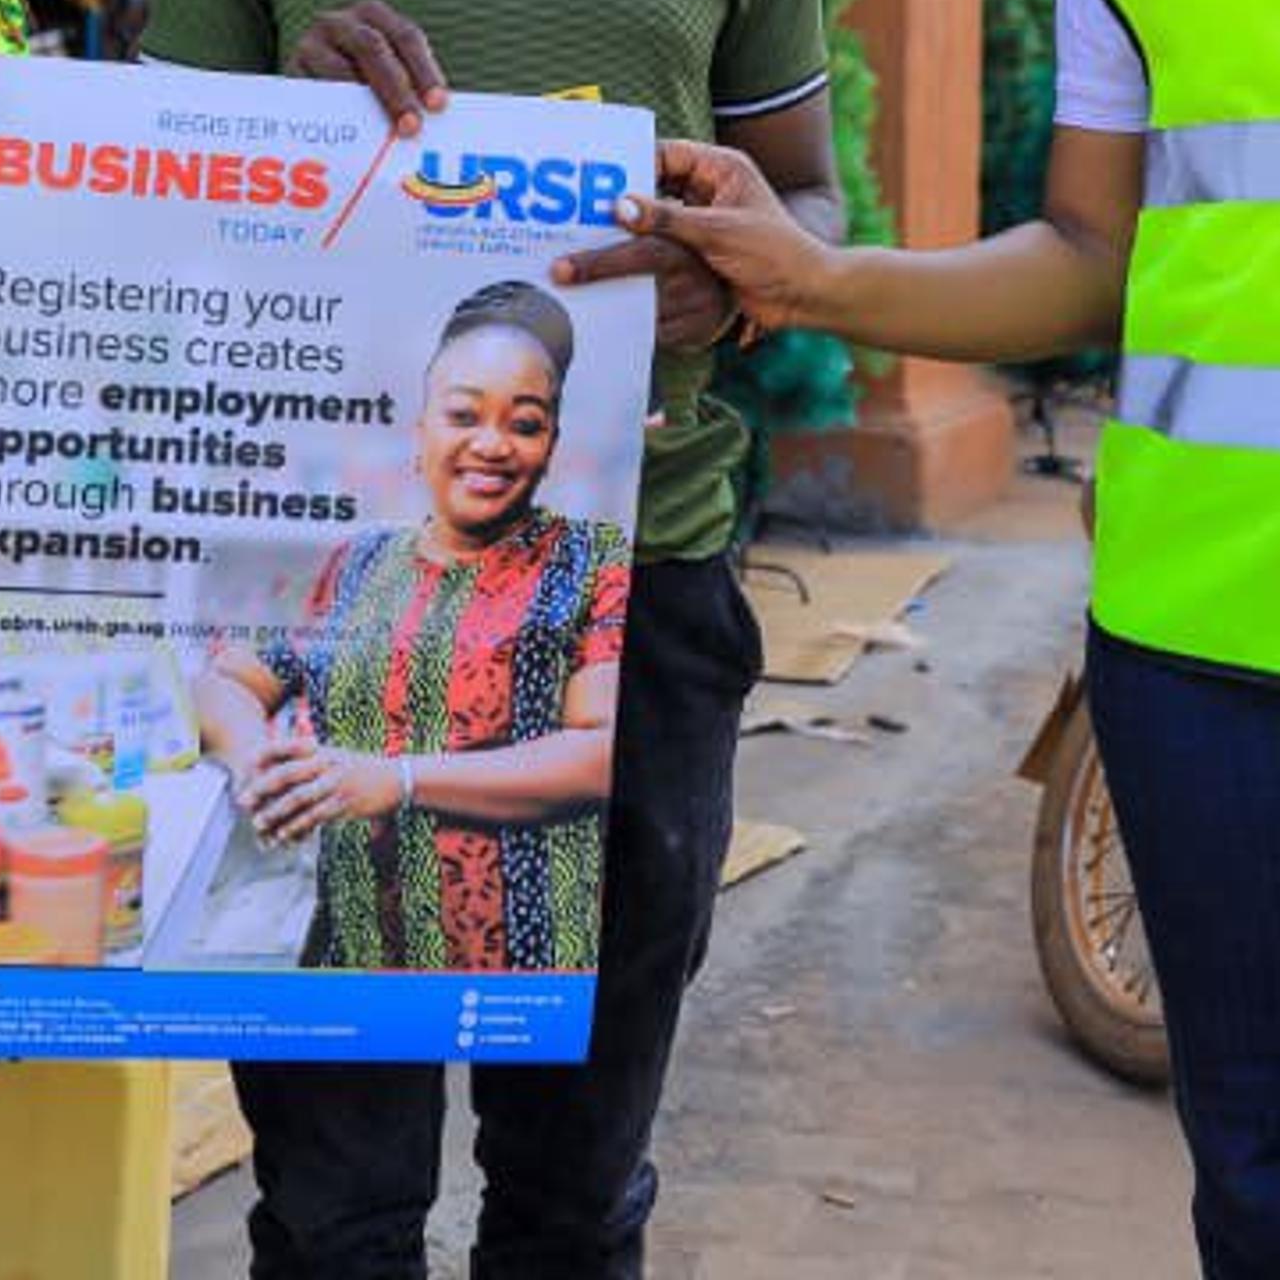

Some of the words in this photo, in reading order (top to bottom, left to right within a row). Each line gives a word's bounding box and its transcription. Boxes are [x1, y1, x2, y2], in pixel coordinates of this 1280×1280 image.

[158, 111, 277, 141] REGISTER
[288, 123, 360, 146] YOUR
[404, 150, 627, 226] URSB
[218, 218, 305, 245] TODAY
[244, 294, 342, 329] your
[185, 335, 344, 373] creates
[100, 380, 395, 427] employment
[151, 477, 357, 521] business
